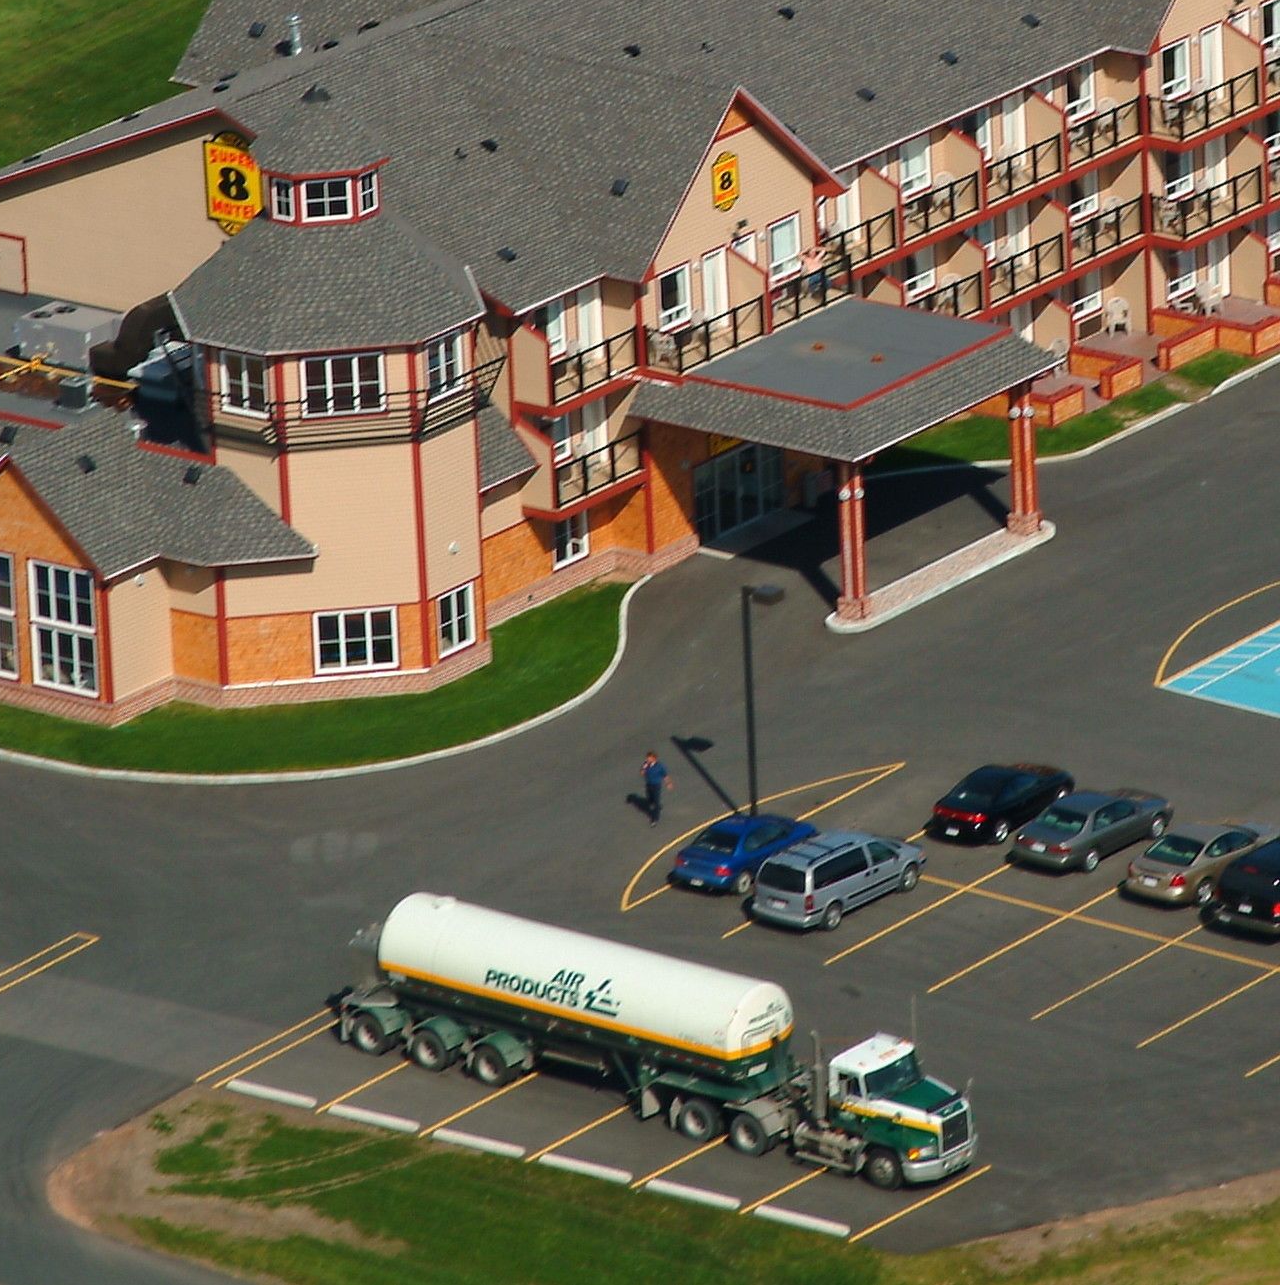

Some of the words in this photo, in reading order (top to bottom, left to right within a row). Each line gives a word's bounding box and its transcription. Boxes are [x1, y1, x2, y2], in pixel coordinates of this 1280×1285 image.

[218, 167, 249, 201] 8
[720, 170, 733, 191] 8
[484, 968, 580, 1008] PRODUCTS
[551, 968, 586, 988] AIR
